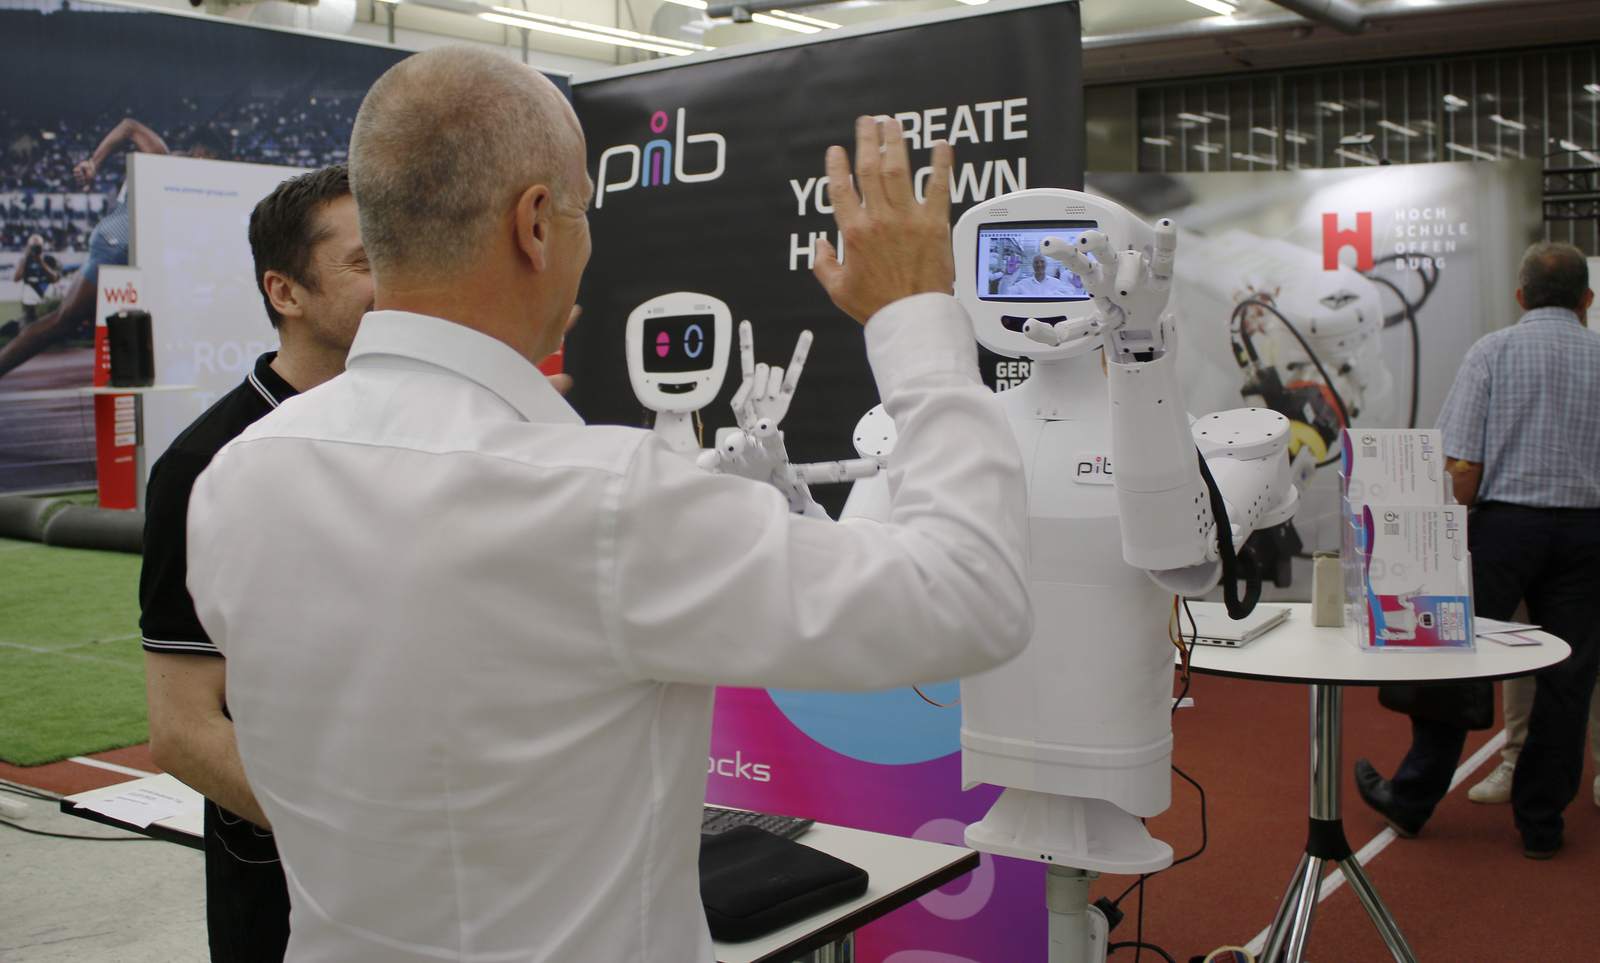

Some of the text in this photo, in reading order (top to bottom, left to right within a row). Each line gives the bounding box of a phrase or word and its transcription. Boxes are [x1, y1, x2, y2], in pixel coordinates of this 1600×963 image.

[595, 107, 726, 209] pib
[1395, 207, 1447, 221] HOCH
[1395, 223, 1468, 238] SCHULE
[1394, 240, 1456, 255] OFFEN
[1395, 257, 1446, 271] BURG
[1443, 511, 1459, 539] pib
